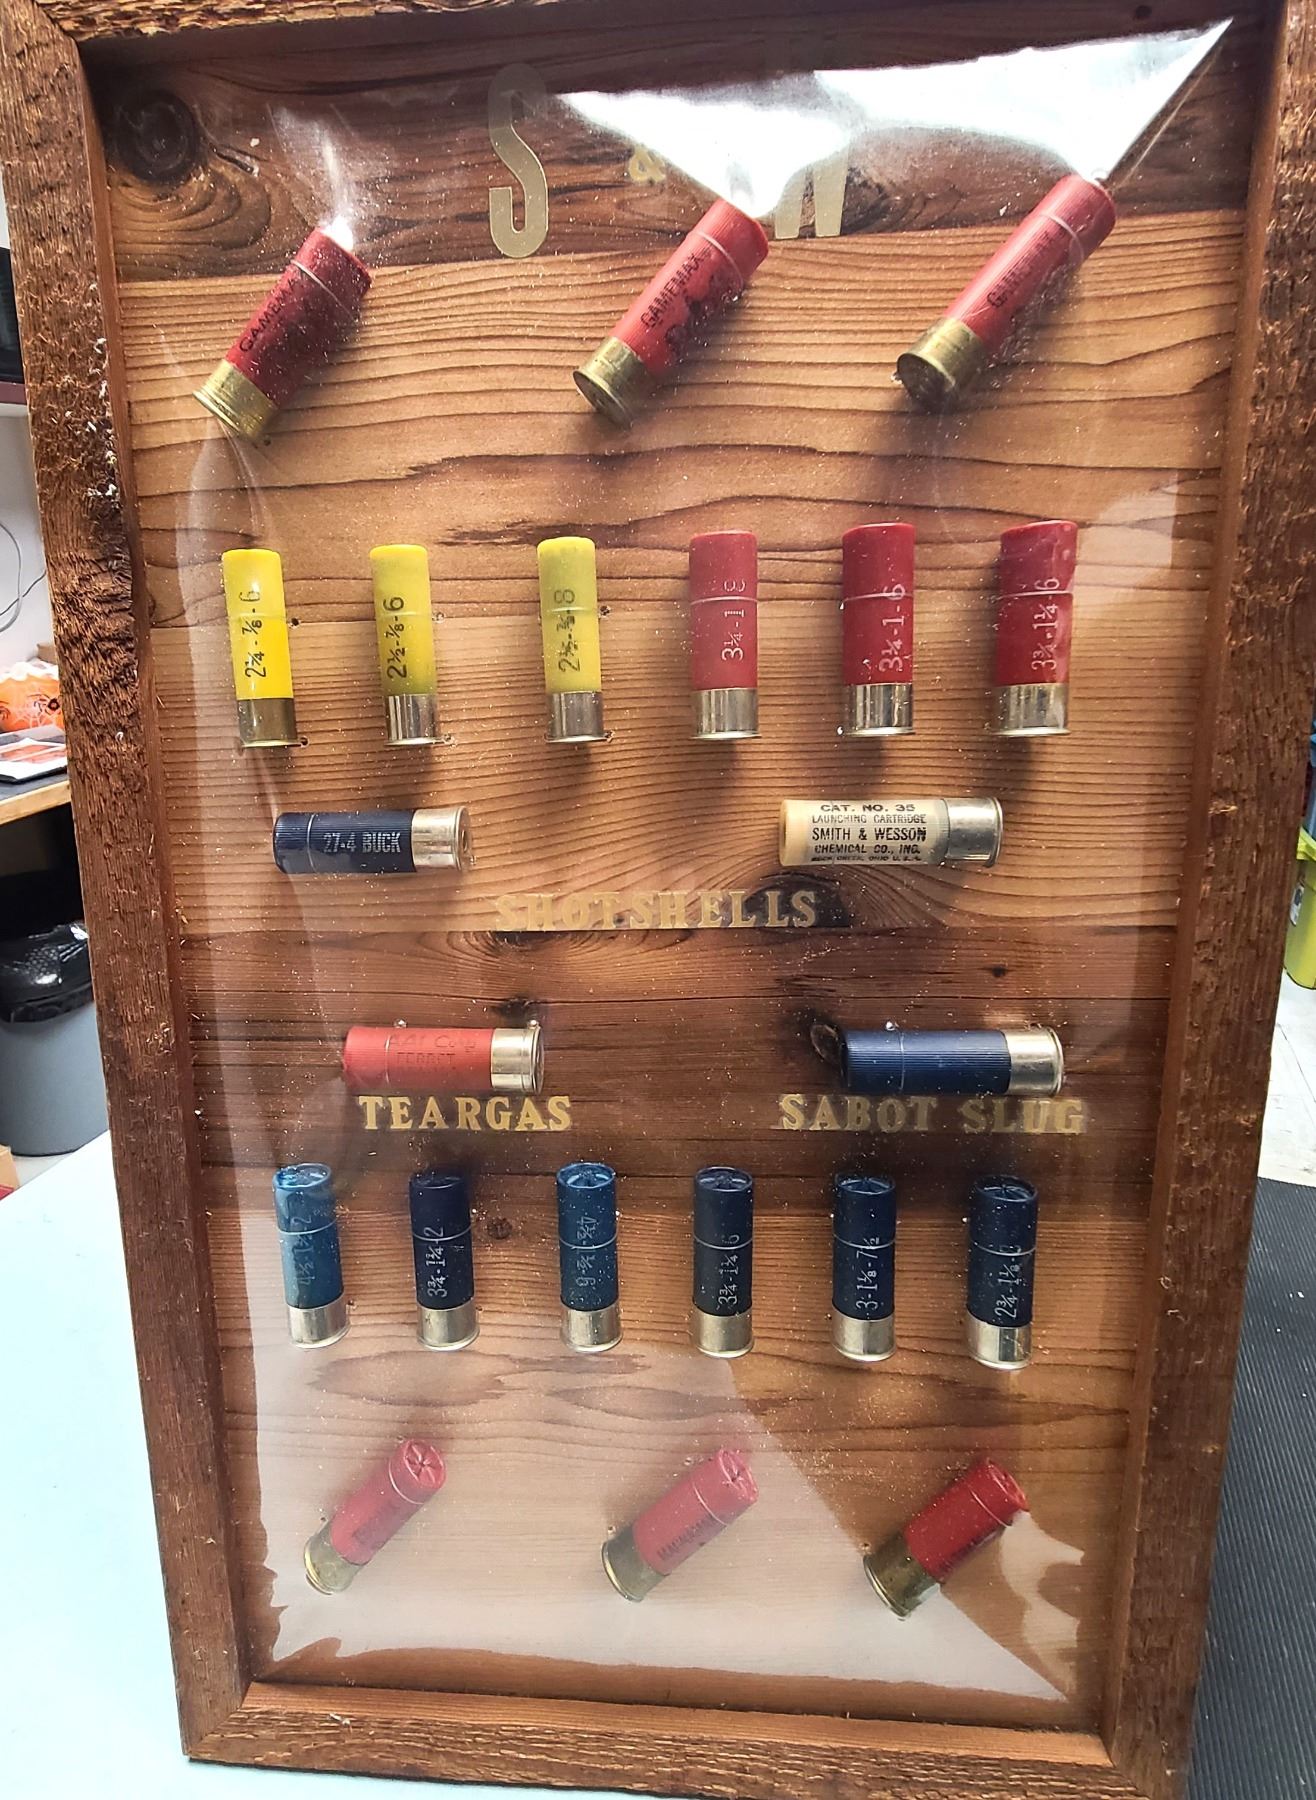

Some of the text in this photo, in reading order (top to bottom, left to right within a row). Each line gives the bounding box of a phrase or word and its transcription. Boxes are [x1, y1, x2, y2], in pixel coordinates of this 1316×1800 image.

[488, 64, 548, 258] S
[640, 252, 704, 329] GAMEMAX
[812, 814, 927, 824] LAUNCHING CARTRIDGE
[820, 804, 916, 812] CAT. NO. 35
[362, 831, 401, 853] BUCK
[812, 827, 927, 842] SMITH & WESSON
[814, 843, 868, 854] CHEMICAL
[495, 889, 818, 931] SHOTSHELLS
[358, 1095, 572, 1131] TEARGAS
[780, 1093, 1085, 1134] SABOT SLUG
